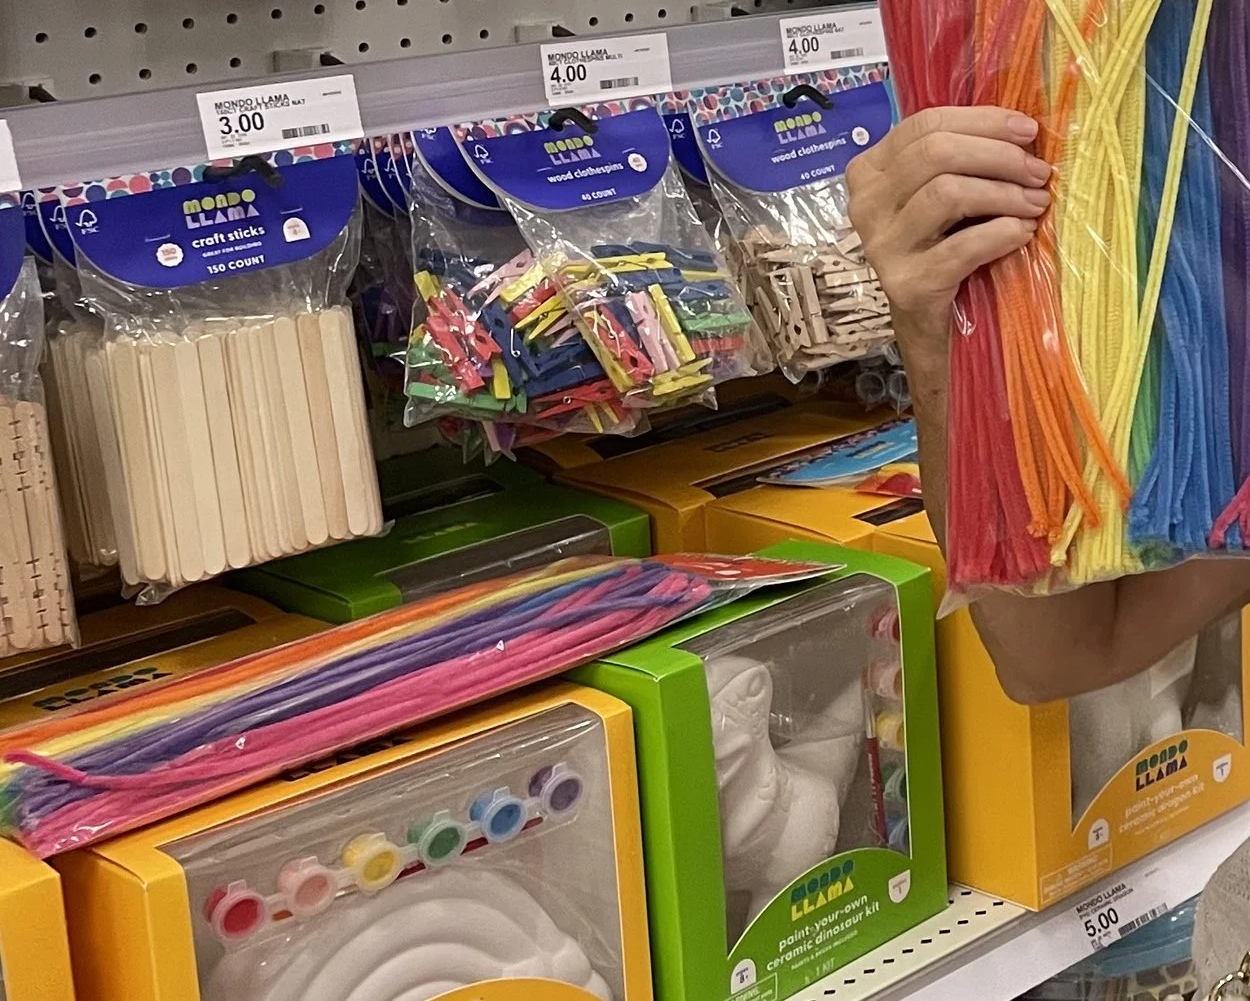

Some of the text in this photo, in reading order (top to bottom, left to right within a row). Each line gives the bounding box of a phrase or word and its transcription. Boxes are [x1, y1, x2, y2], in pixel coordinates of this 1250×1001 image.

[786, 22, 837, 35] MONDO LLAMA
[548, 48, 609, 62] MONDO LLAMA
[788, 37, 819, 55] 4.00
[550, 64, 587, 83] 4.00
[214, 93, 290, 110] MONDO LLAMA
[219, 112, 264, 135] 3.00
[774, 111, 822, 133] MONDO
[544, 135, 594, 155] MONDO
[778, 123, 827, 145] LLAMA
[550, 148, 602, 166] LLAMA
[771, 137, 847, 164] wood clothespins
[547, 162, 624, 184] wood clothespins
[811, 165, 836, 178] COUNT
[183, 189, 256, 215] MONDO
[592, 189, 618, 199] COUNT
[186, 204, 260, 229] LLAMA
[192, 226, 265, 248] craft sticks
[207, 255, 265, 274] 150 COUNT
[1135, 739, 1188, 776] MONDO
[1135, 755, 1189, 792] LLAMA
[790, 858, 854, 903] MONDO
[791, 876, 855, 922] LLAMA
[1076, 883, 1127, 914] MONDO LLAMA
[778, 895, 868, 952] paint-your-own
[1084, 908, 1119, 937] 5.00
[766, 901, 881, 971] ceramic dinosaur kit
